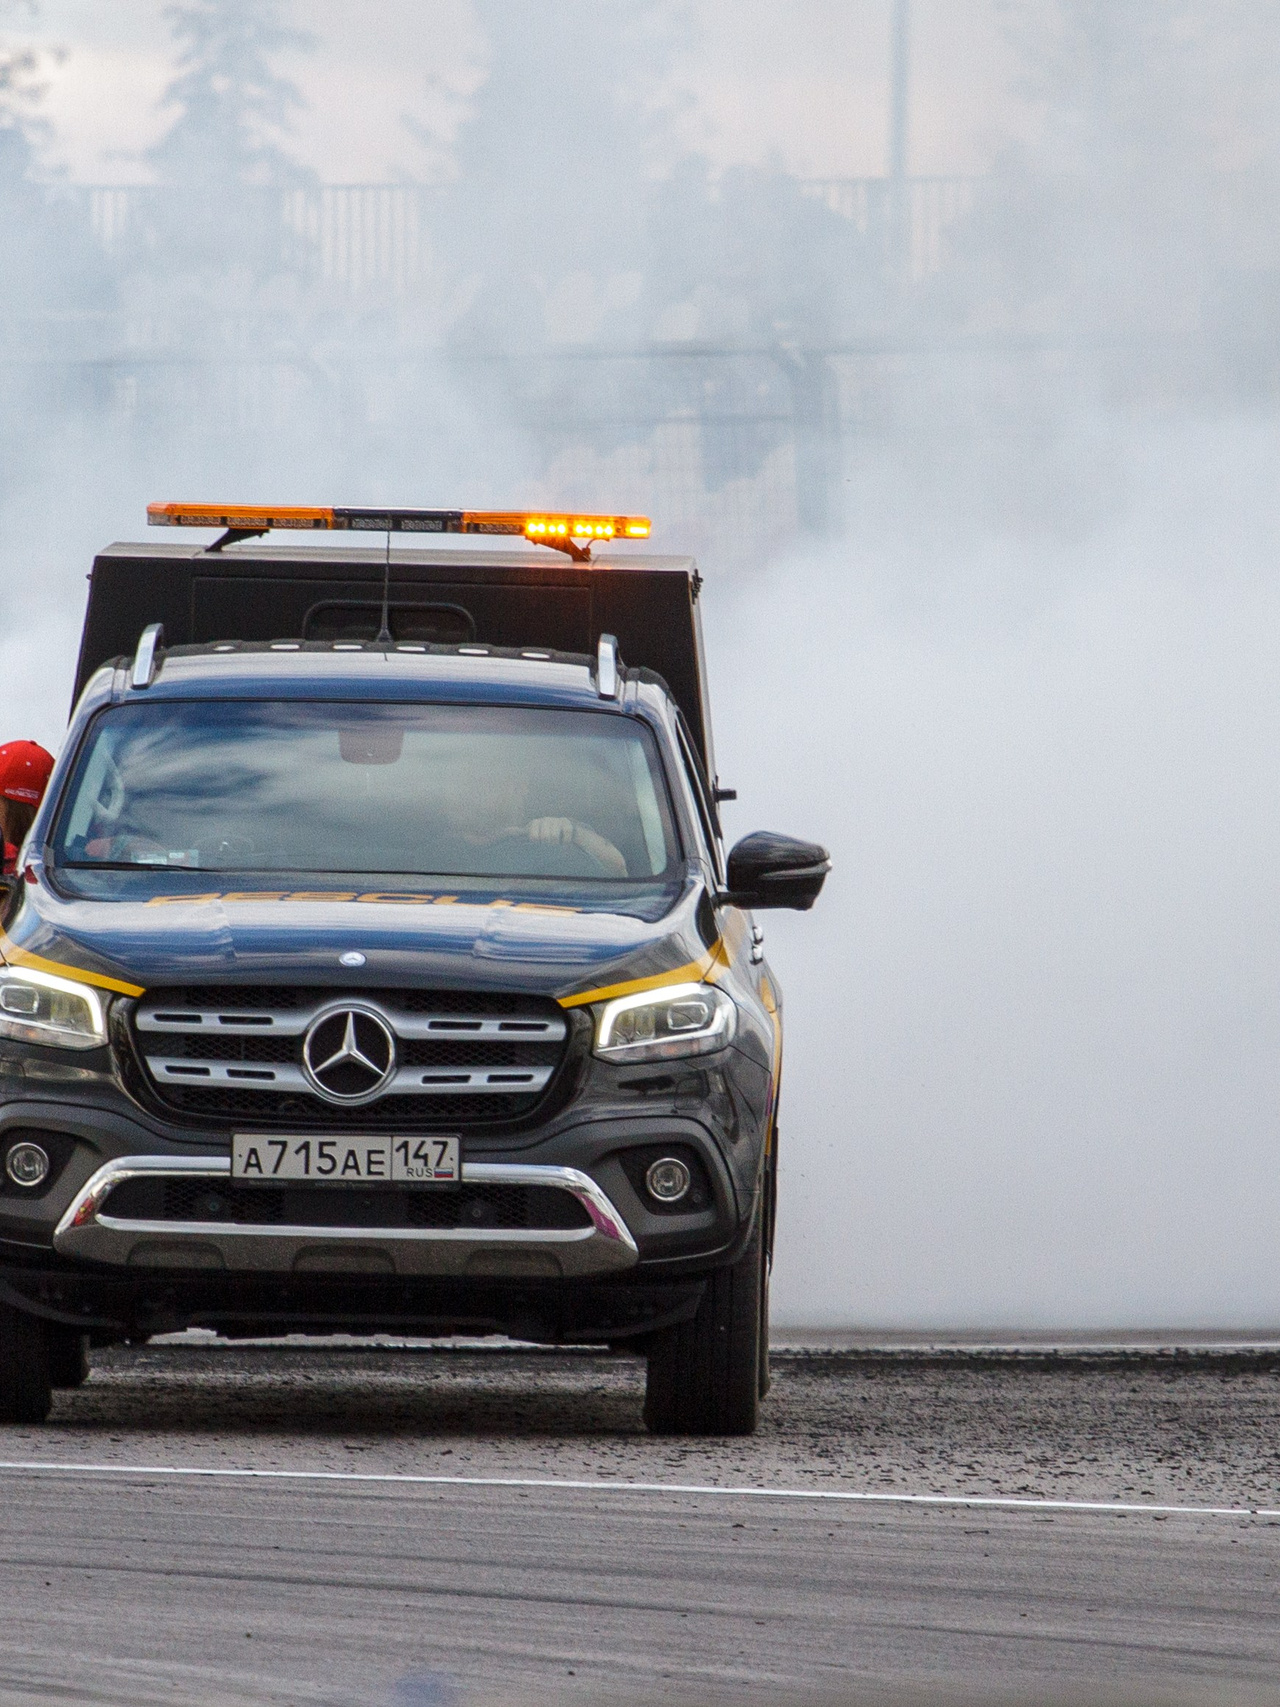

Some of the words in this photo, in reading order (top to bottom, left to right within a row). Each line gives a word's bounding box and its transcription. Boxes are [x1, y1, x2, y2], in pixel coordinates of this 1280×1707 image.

[243, 1140, 386, 1176] A715AE
[394, 1140, 449, 1168] 147
[406, 1167, 433, 1178] RUS
